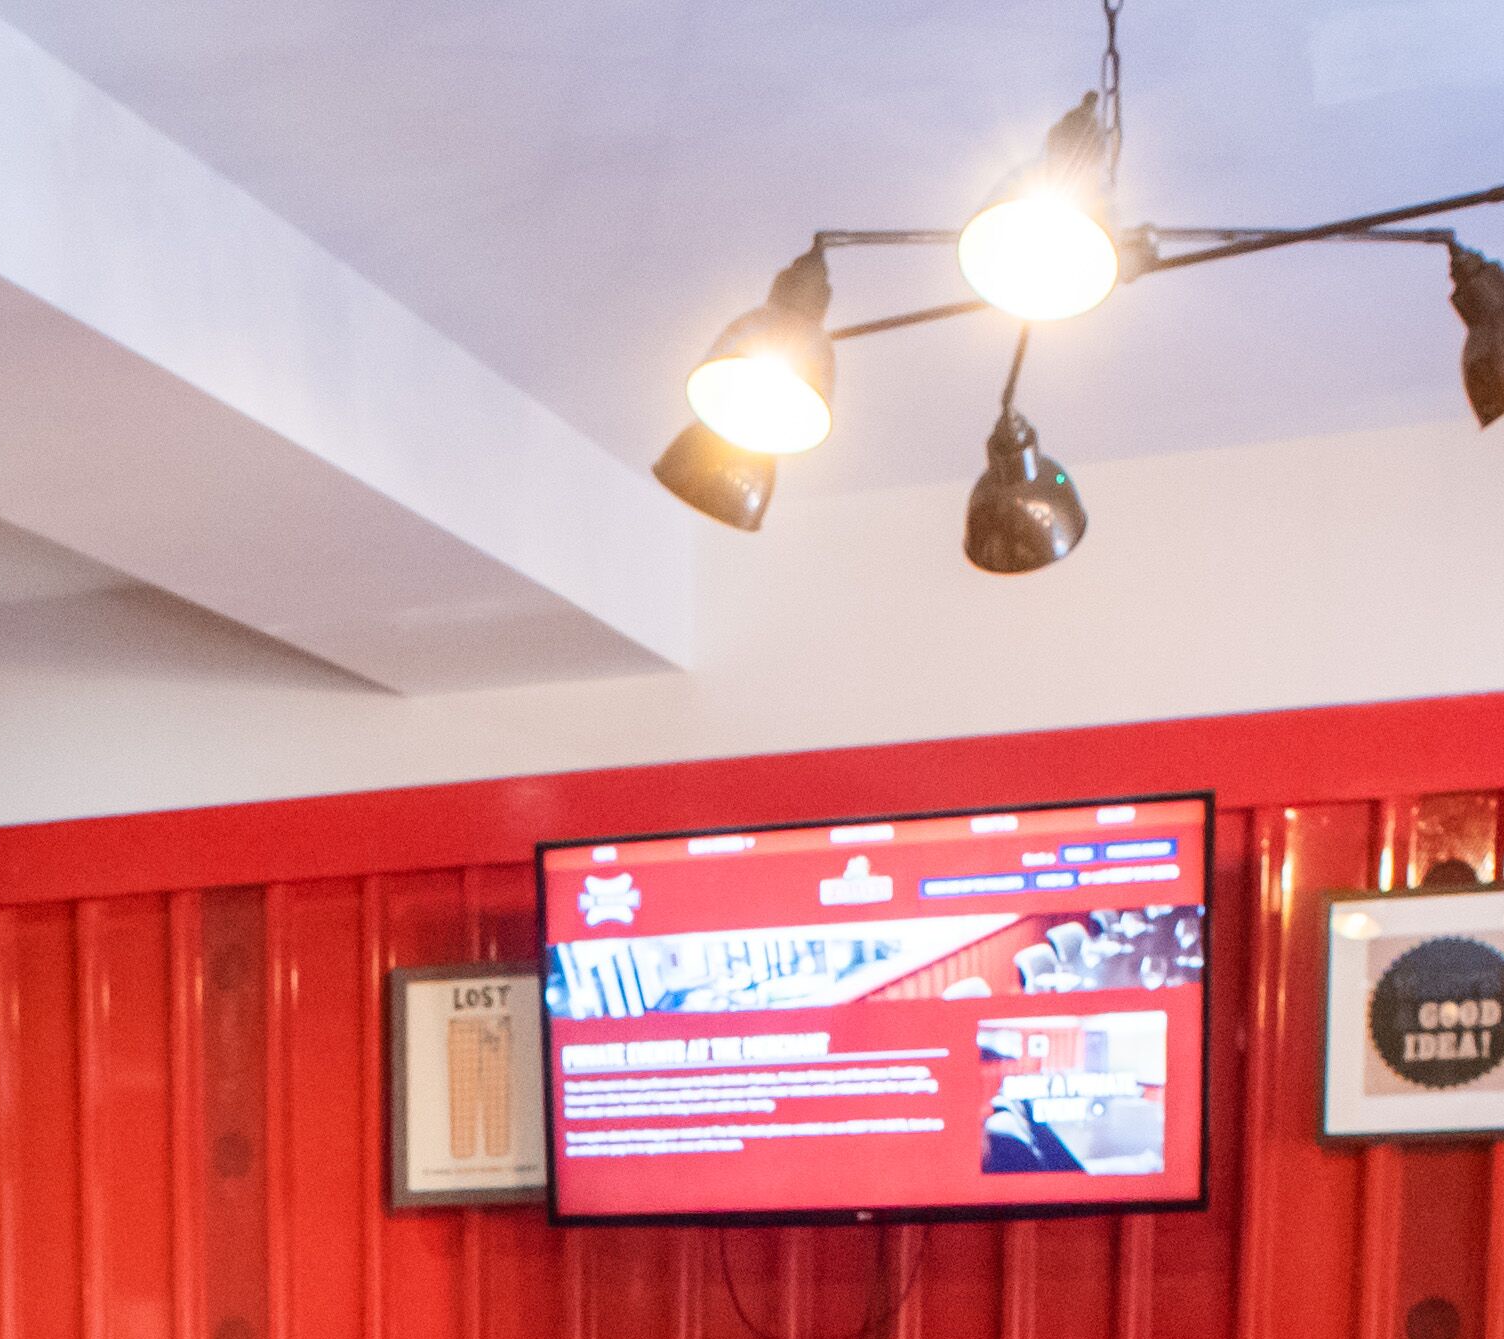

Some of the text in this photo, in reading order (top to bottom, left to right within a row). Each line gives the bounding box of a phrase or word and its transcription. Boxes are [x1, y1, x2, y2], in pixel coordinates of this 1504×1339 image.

[452, 985, 512, 1010] LOST
[1420, 1000, 1501, 1028] GOOD
[1405, 1030, 1491, 1061] IDEA!
